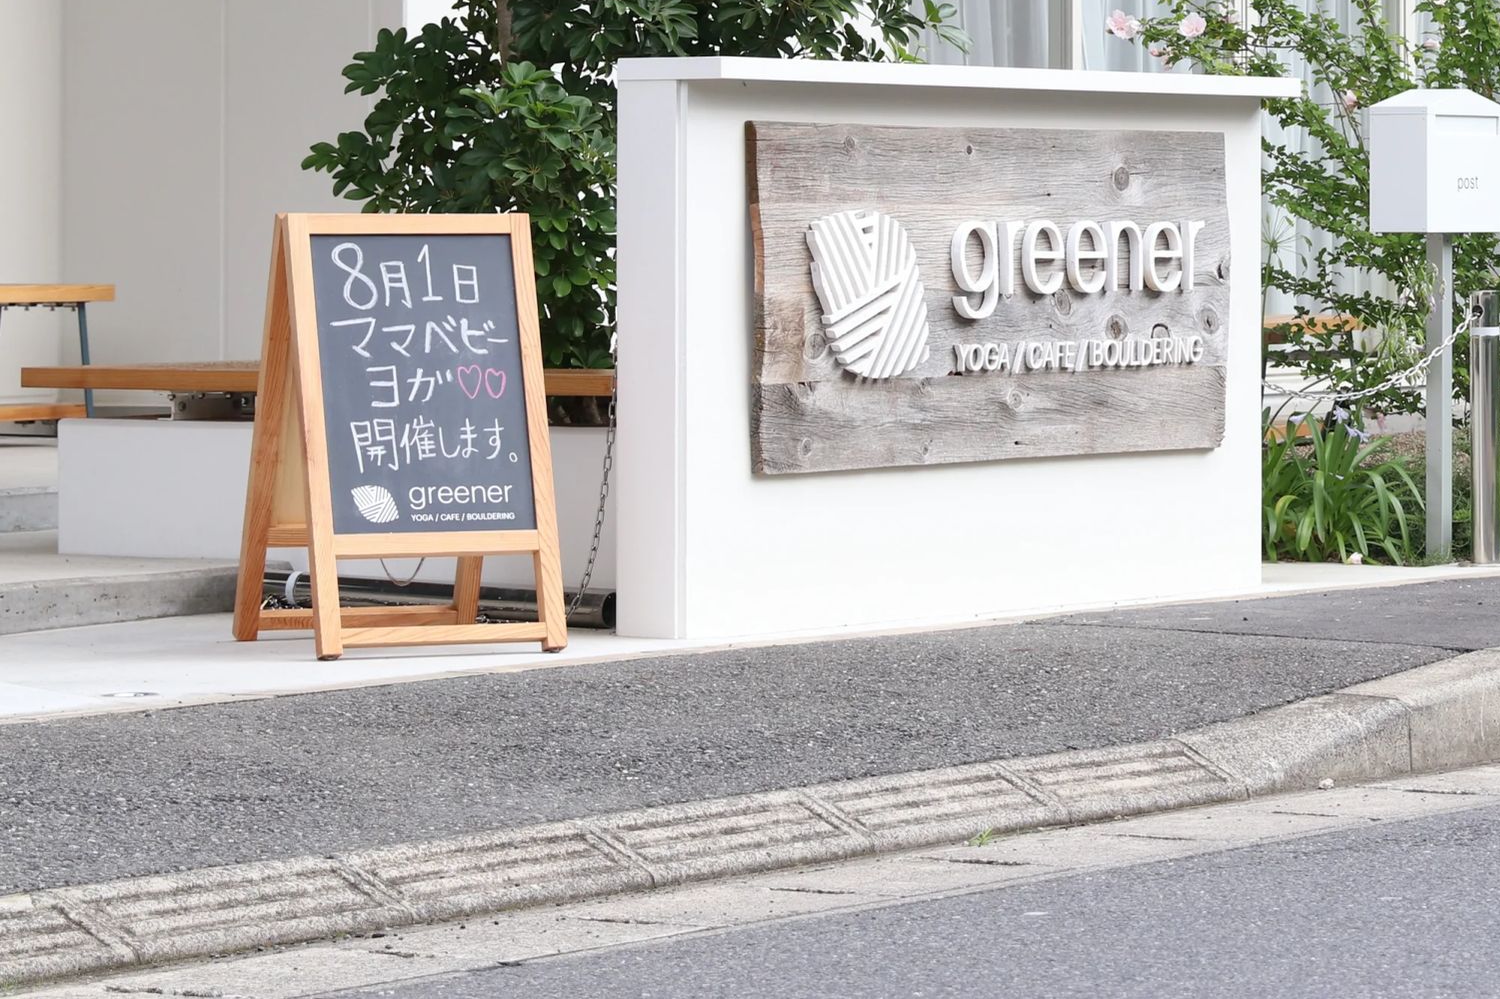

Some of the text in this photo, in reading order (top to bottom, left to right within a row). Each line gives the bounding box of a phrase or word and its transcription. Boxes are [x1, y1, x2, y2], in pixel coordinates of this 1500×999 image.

[1457, 176, 1479, 192] post
[331, 242, 480, 310] 8月1日
[951, 219, 1205, 320] greener
[330, 314, 509, 359] ママベビー
[366, 364, 453, 408] ヨガ
[350, 414, 518, 474] 開催します。
[408, 484, 513, 510] greener
[411, 513, 434, 522] YOGA
[440, 513, 460, 521] CAFE
[466, 512, 516, 521] BOULDERING
